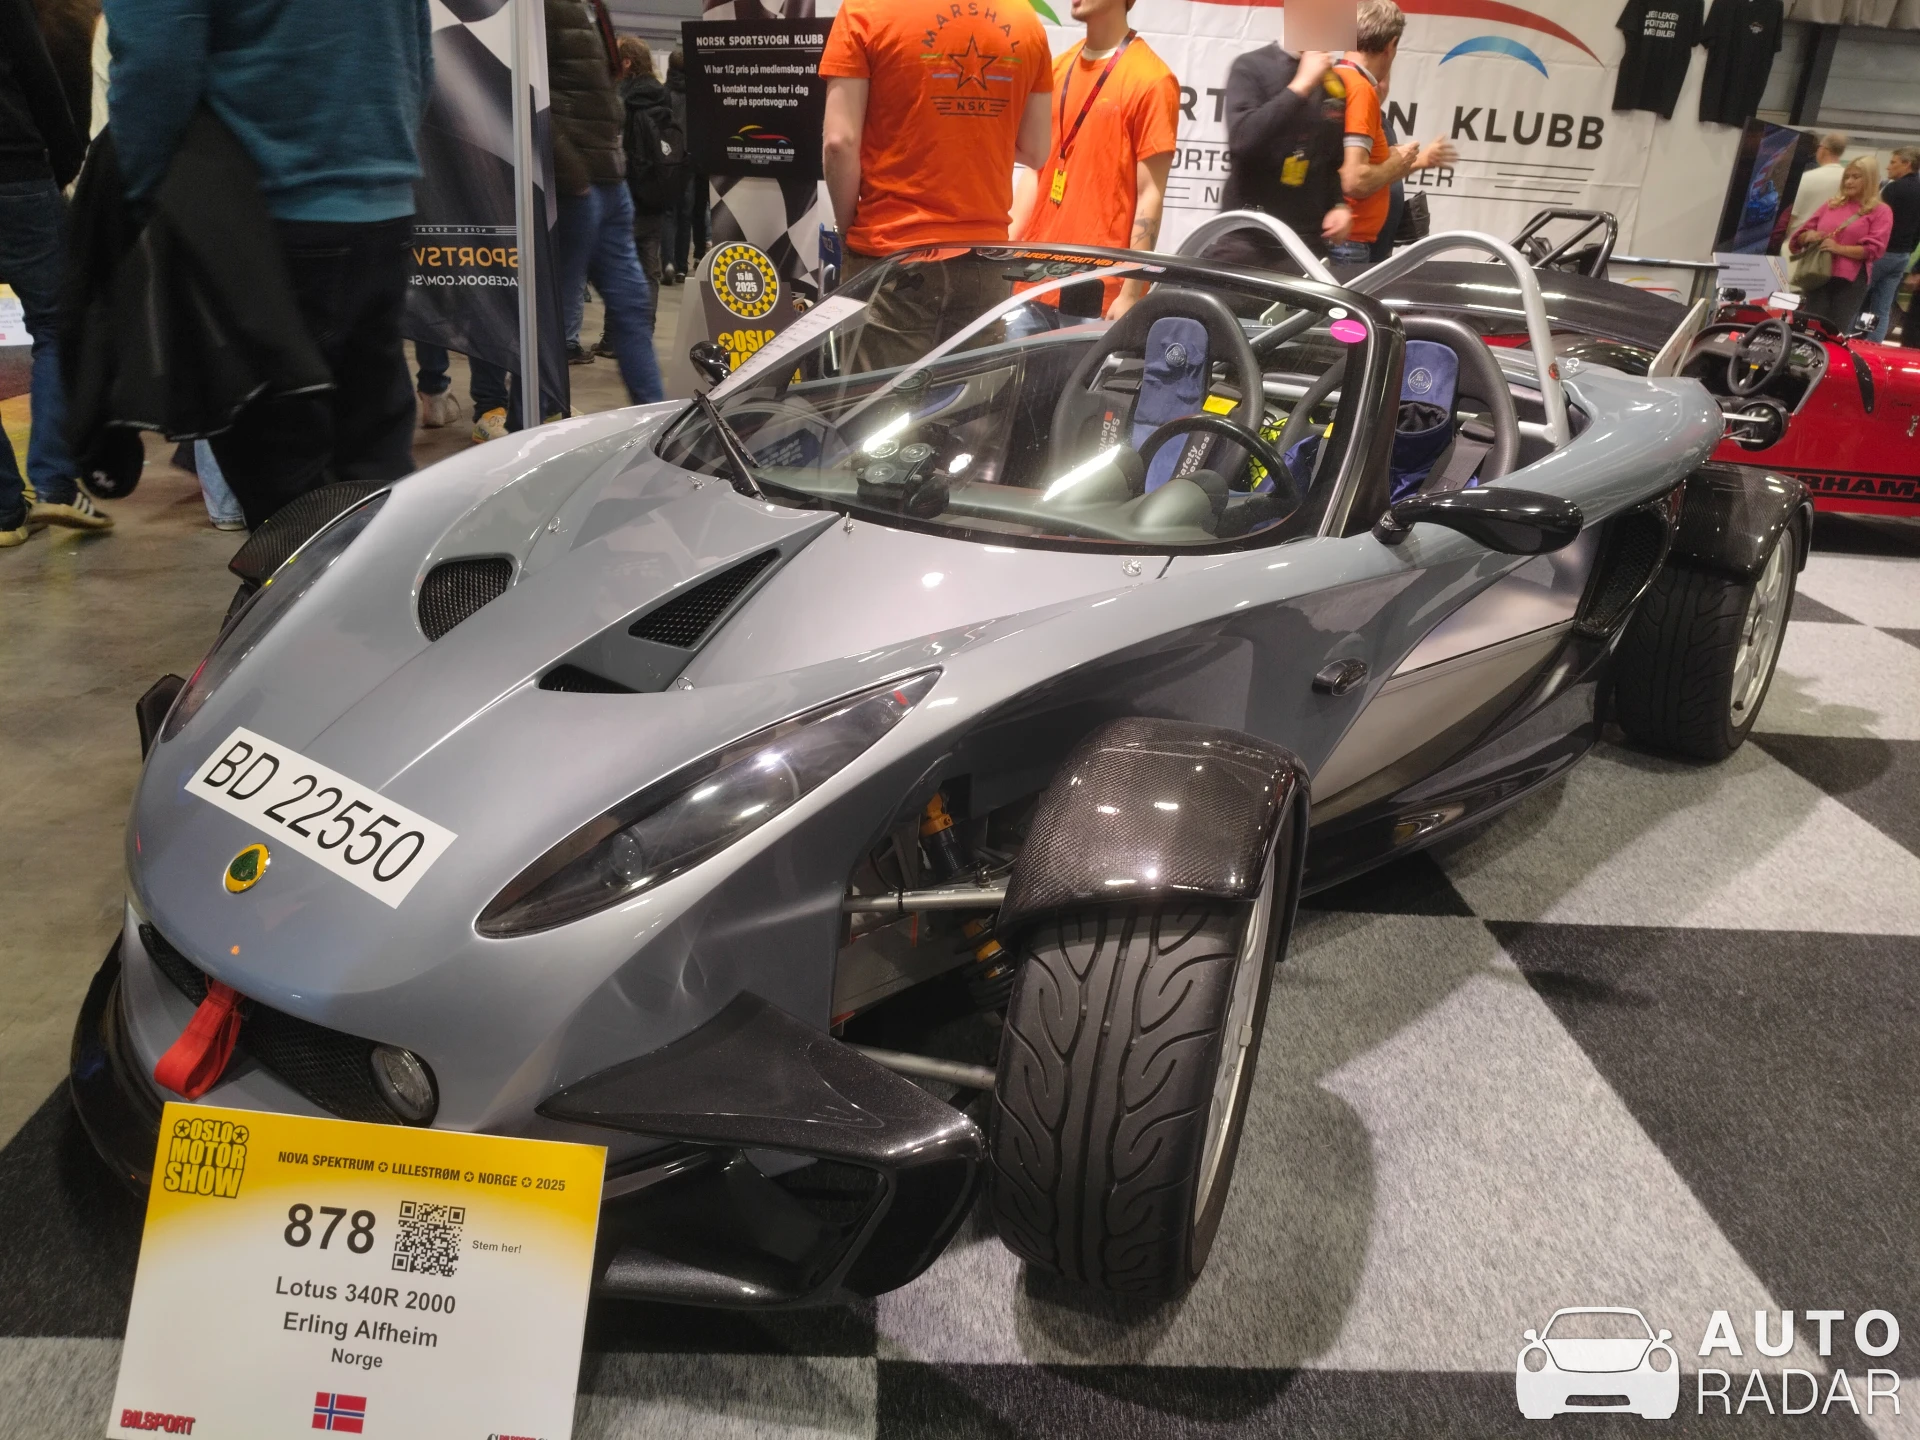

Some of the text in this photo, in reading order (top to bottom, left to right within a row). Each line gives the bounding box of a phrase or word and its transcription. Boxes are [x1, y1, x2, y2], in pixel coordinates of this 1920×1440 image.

[696, 34, 824, 46] NORSK SPORTSVOGN KLUBB
[922, 2, 1021, 53] MARSHAL
[704, 63, 817, 76] Vi har 1/2 pris på medlemskap nå!
[713, 84, 721, 93] Ta
[722, 84, 747, 93] kontakt
[748, 84, 762, 93] med
[777, 84, 790, 94] her
[795, 84, 809, 96] dag
[723, 96, 798, 108] eller på sportsvogn.no
[957, 101, 986, 111] NSK
[1451, 105, 1605, 150] KLUBB
[735, 282, 758, 292] 2025
[1187, 435, 1210, 475] evices
[203, 740, 280, 801] BD
[263, 774, 425, 882] 22550
[189, 1118, 234, 1143] OSLO
[169, 1137, 247, 1170] MOTOR
[164, 1161, 244, 1199] SHOW
[278, 1151, 566, 1192] NOVA SPEKTRUM LILLESTRØM NORGE 2025
[284, 1203, 376, 1254] 878
[472, 1240, 522, 1254] Stem her!
[275, 1276, 456, 1314] Lotus 340R 2000
[283, 1311, 438, 1347] Erling Alfheim
[331, 1347, 383, 1371] Norge
[120, 1408, 196, 1435] BILSPORT
